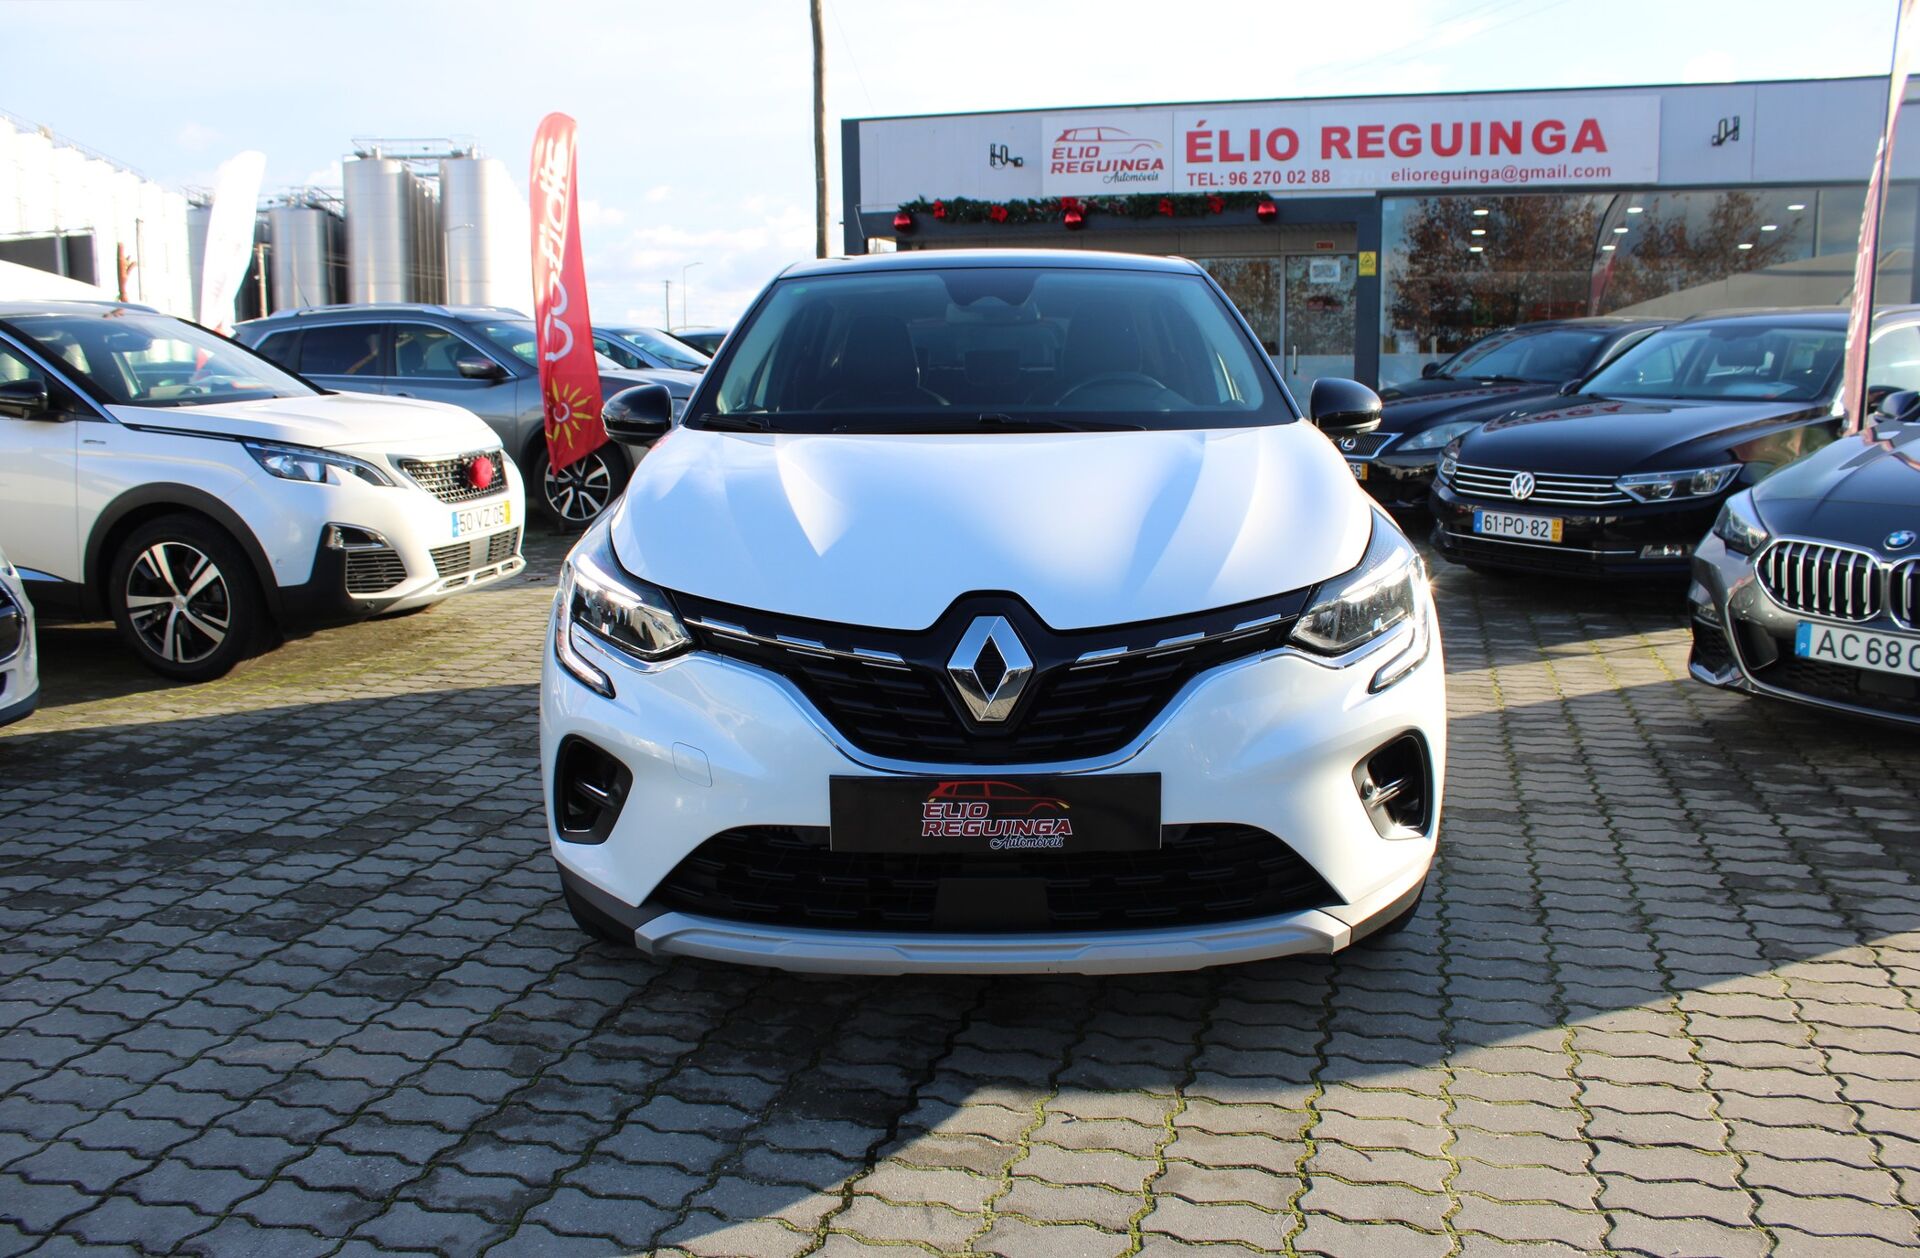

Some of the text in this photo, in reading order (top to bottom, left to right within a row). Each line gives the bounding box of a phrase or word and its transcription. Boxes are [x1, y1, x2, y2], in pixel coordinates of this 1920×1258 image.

[1186, 118, 1608, 164] ÉLIO REGUINGA
[1051, 145, 1101, 160] ELIO
[1050, 158, 1165, 174] REGUINGA
[1391, 164, 1612, 185] elioreguinga@gmail.com
[1103, 171, 1159, 184] Automóveis
[1187, 169, 1330, 186] TEL: 96 270 02 88
[921, 802, 990, 819] ELIO
[921, 818, 1073, 837] REGUINGA
[990, 834, 1064, 850] Automóveis
